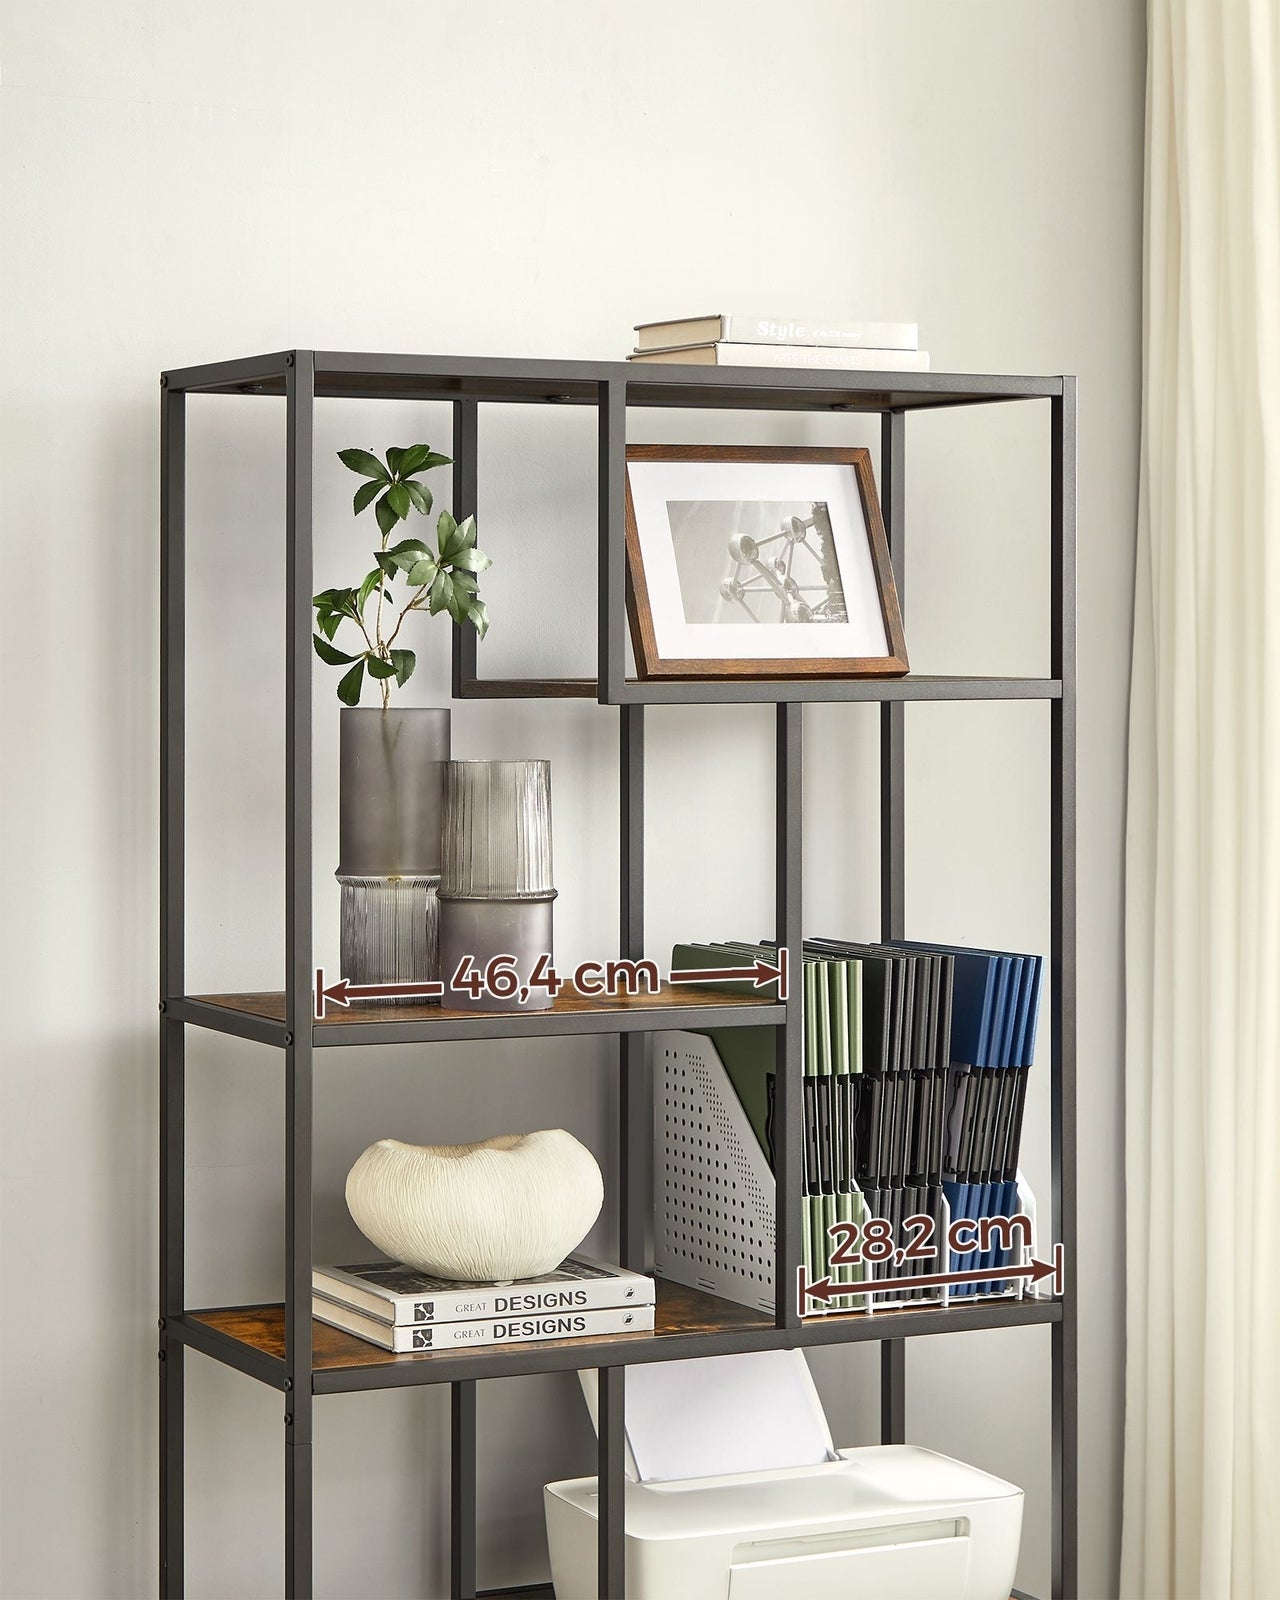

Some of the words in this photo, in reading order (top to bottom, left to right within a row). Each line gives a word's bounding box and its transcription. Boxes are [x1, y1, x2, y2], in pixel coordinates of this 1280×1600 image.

[757, 321, 805, 341] Style
[455, 1303, 487, 1313] GREAT
[494, 1291, 588, 1313] DESIGNS
[453, 1329, 485, 1340] GREAT
[493, 1317, 586, 1339] DESIGNS
